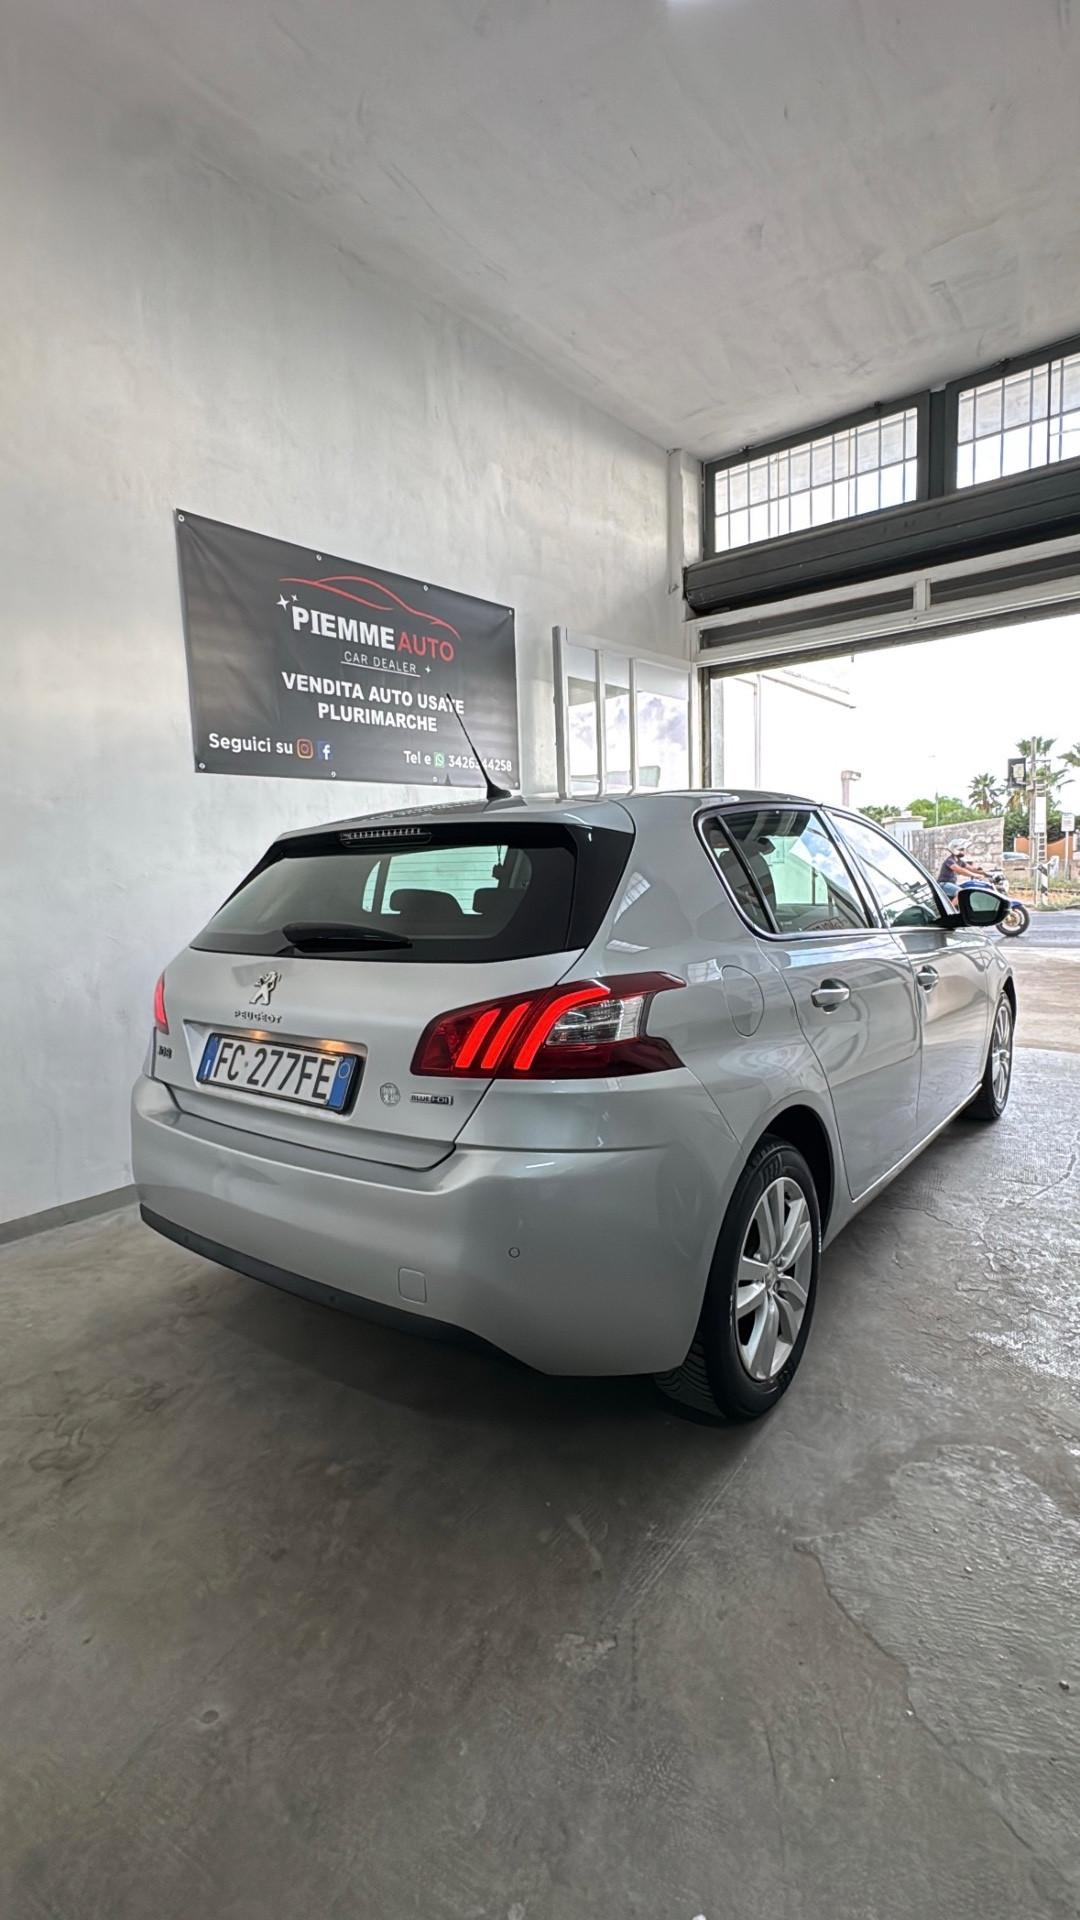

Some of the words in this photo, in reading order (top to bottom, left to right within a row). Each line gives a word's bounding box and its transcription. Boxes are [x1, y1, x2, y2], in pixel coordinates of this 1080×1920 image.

[291, 605, 396, 650] PIEMME
[397, 631, 455, 661] AUTO
[344, 650, 369, 664] CAR
[373, 656, 417, 673] DEALER
[281, 671, 365, 700] VENDITA
[368, 686, 413, 706] AUTO
[417, 693, 465, 714] USATE
[317, 702, 438, 732] PLURIMARCHE
[208, 732, 271, 753] Seguici
[276, 742, 294, 754] su
[403, 750, 421, 764] Tel
[424, 754, 432, 765] e
[234, 1010, 283, 1024] PEUGEOT
